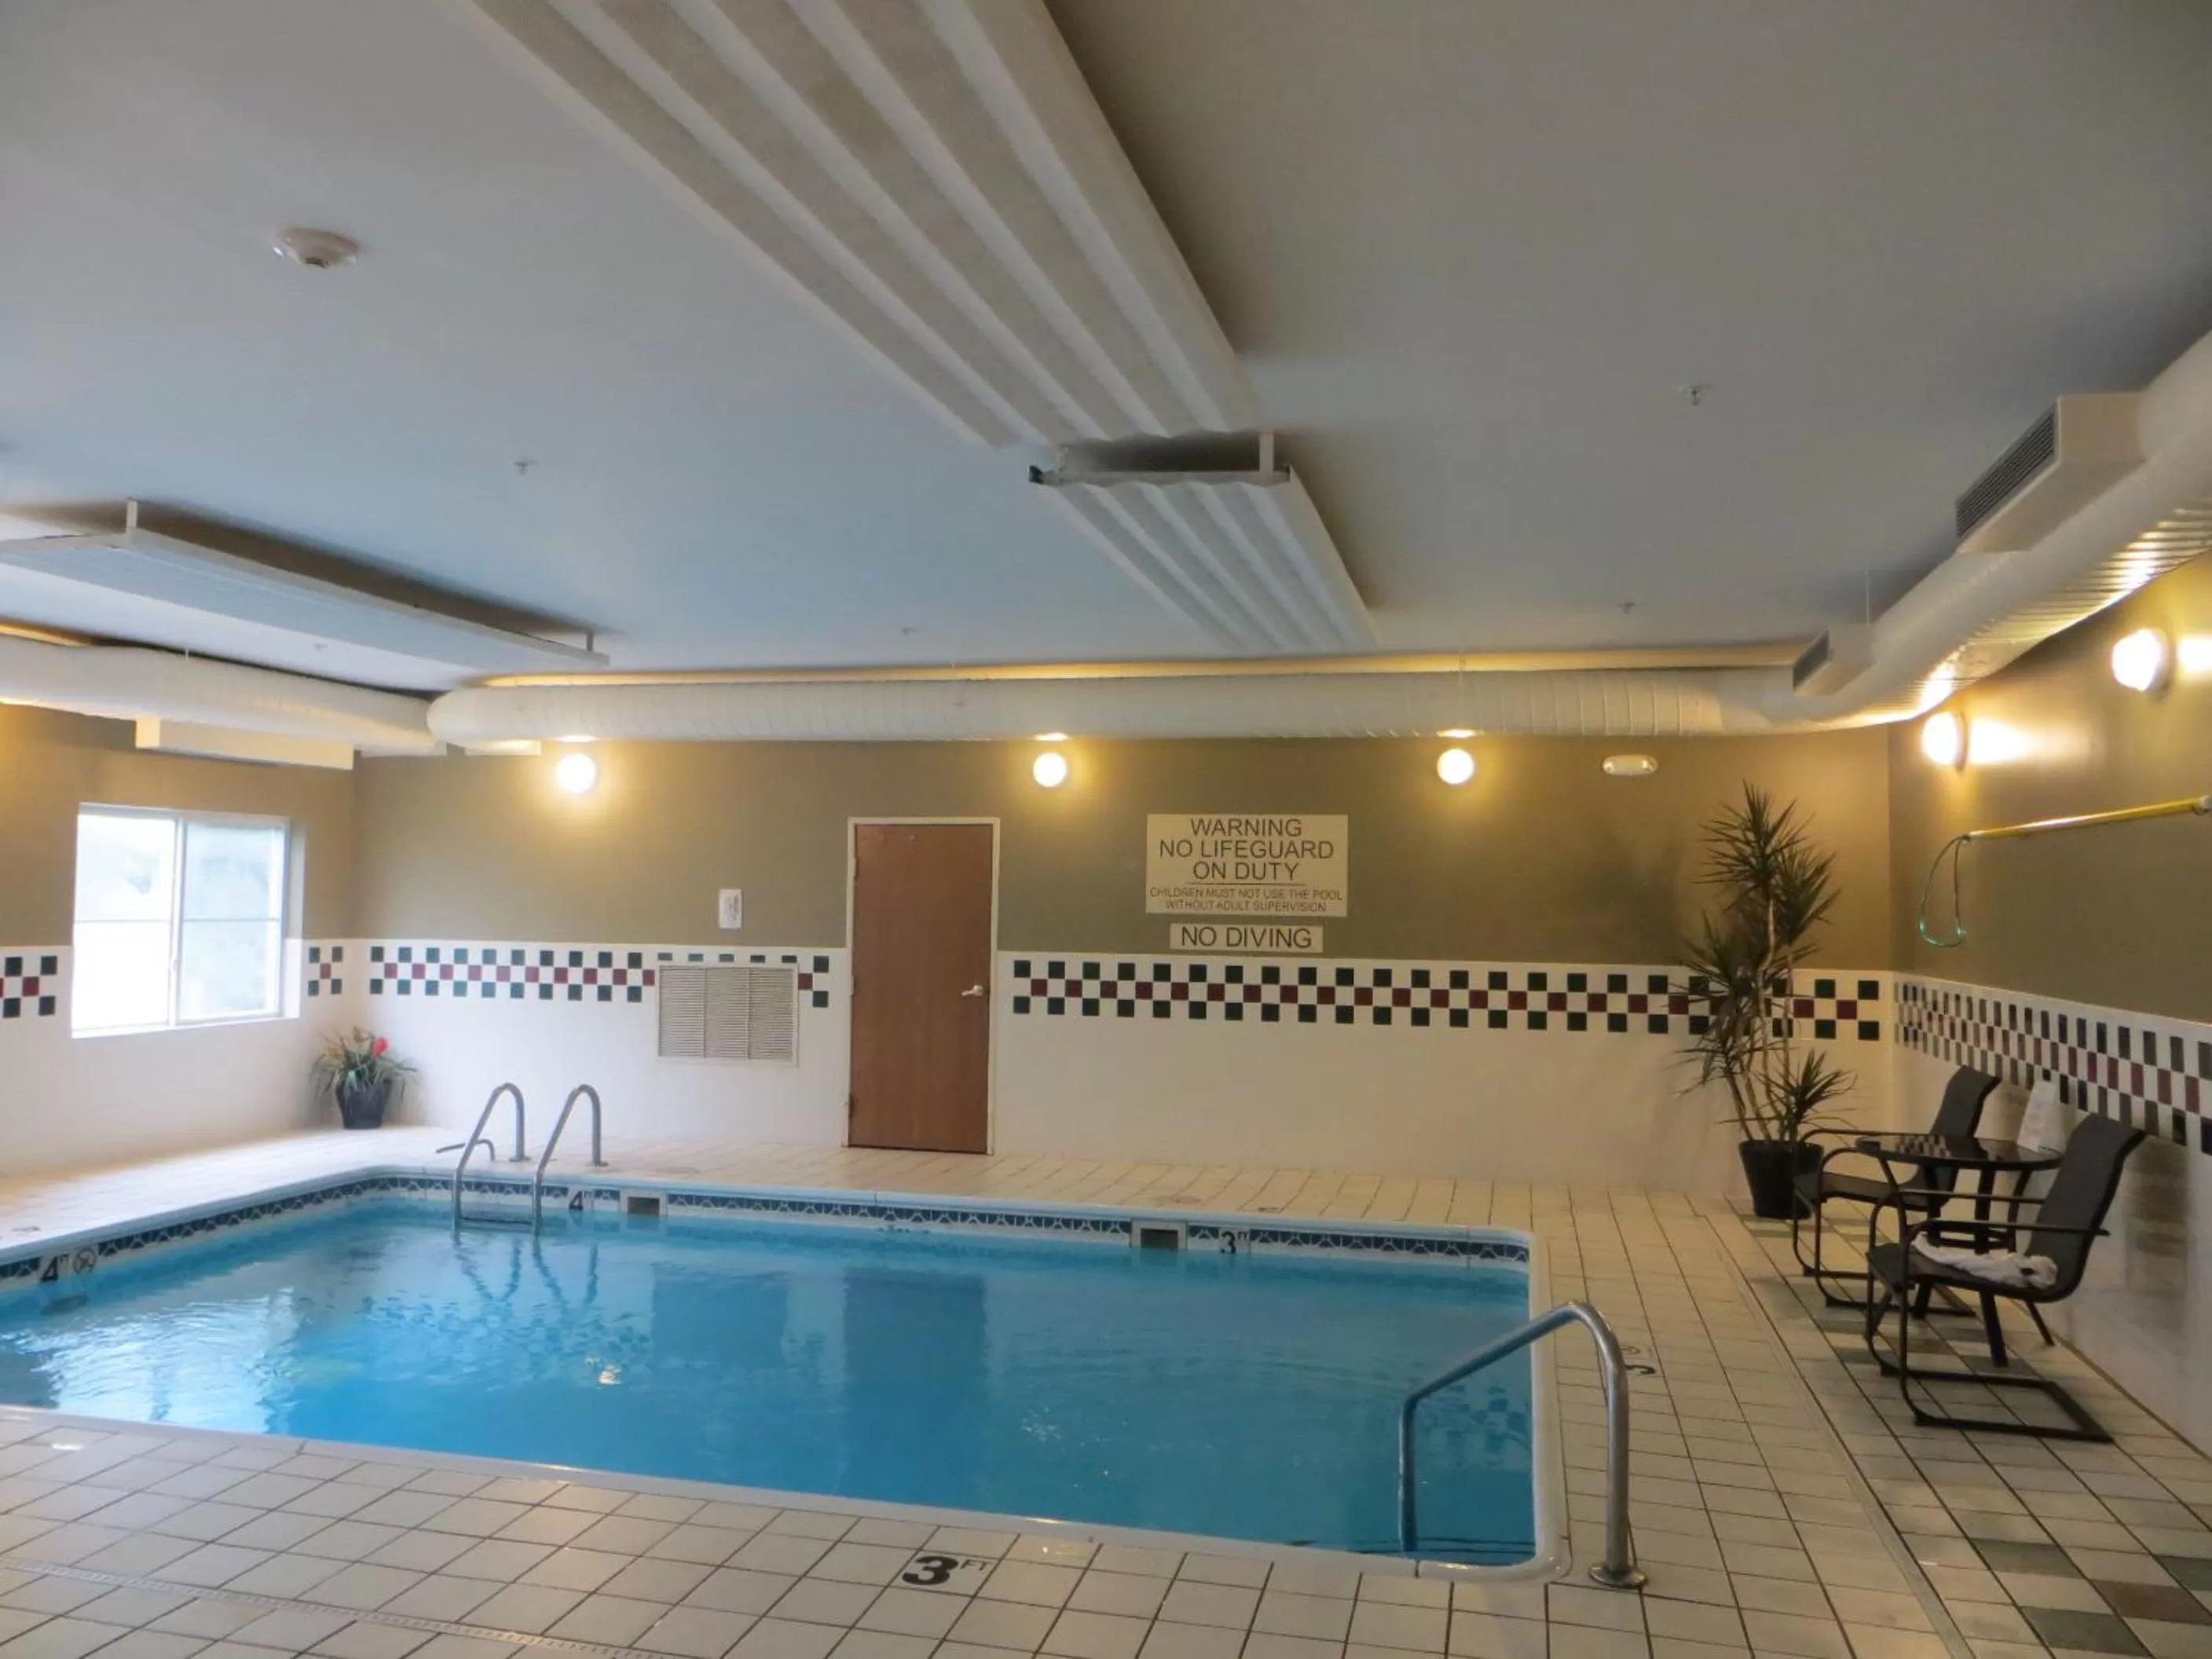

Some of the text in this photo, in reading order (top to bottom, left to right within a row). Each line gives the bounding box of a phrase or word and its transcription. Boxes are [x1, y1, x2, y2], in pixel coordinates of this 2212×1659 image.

[1191, 818, 1302, 837] WARNING
[1159, 838, 1334, 859] NO LIFEGUARD
[1192, 861, 1299, 881] ON DUTY
[1149, 887, 1342, 901] CHILDREN MUST NOT USE THE POOL
[1166, 900, 1327, 913] WITHOUT ADULT SUPERVISION
[1181, 926, 1312, 949] NO DIVING
[569, 1190, 583, 1210] 4
[1221, 1231, 1236, 1254] 3
[41, 1256, 59, 1282] 4
[901, 1555, 990, 1586] 3 FT
